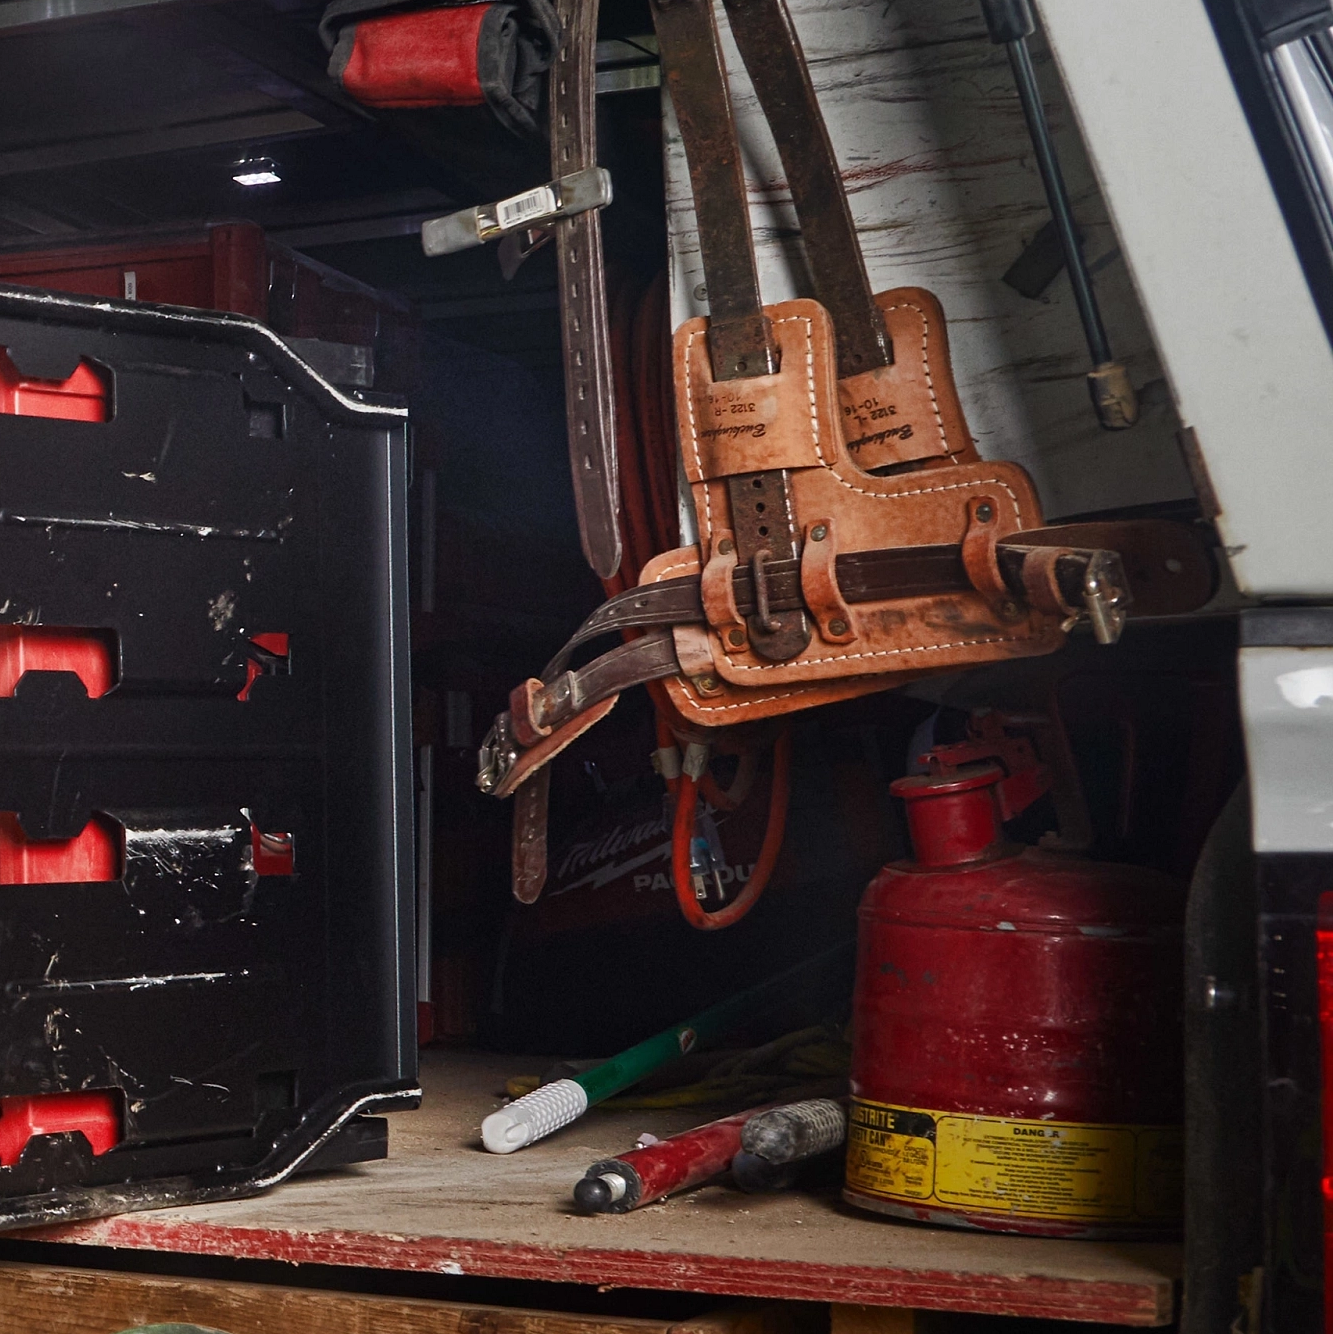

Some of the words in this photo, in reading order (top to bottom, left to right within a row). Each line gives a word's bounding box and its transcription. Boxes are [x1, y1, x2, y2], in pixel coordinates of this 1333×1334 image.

[730, 402, 756, 414] 3122
[844, 397, 879, 416] 10-16
[870, 405, 897, 421] 3122
[1013, 1127, 1061, 1139] DANGR
